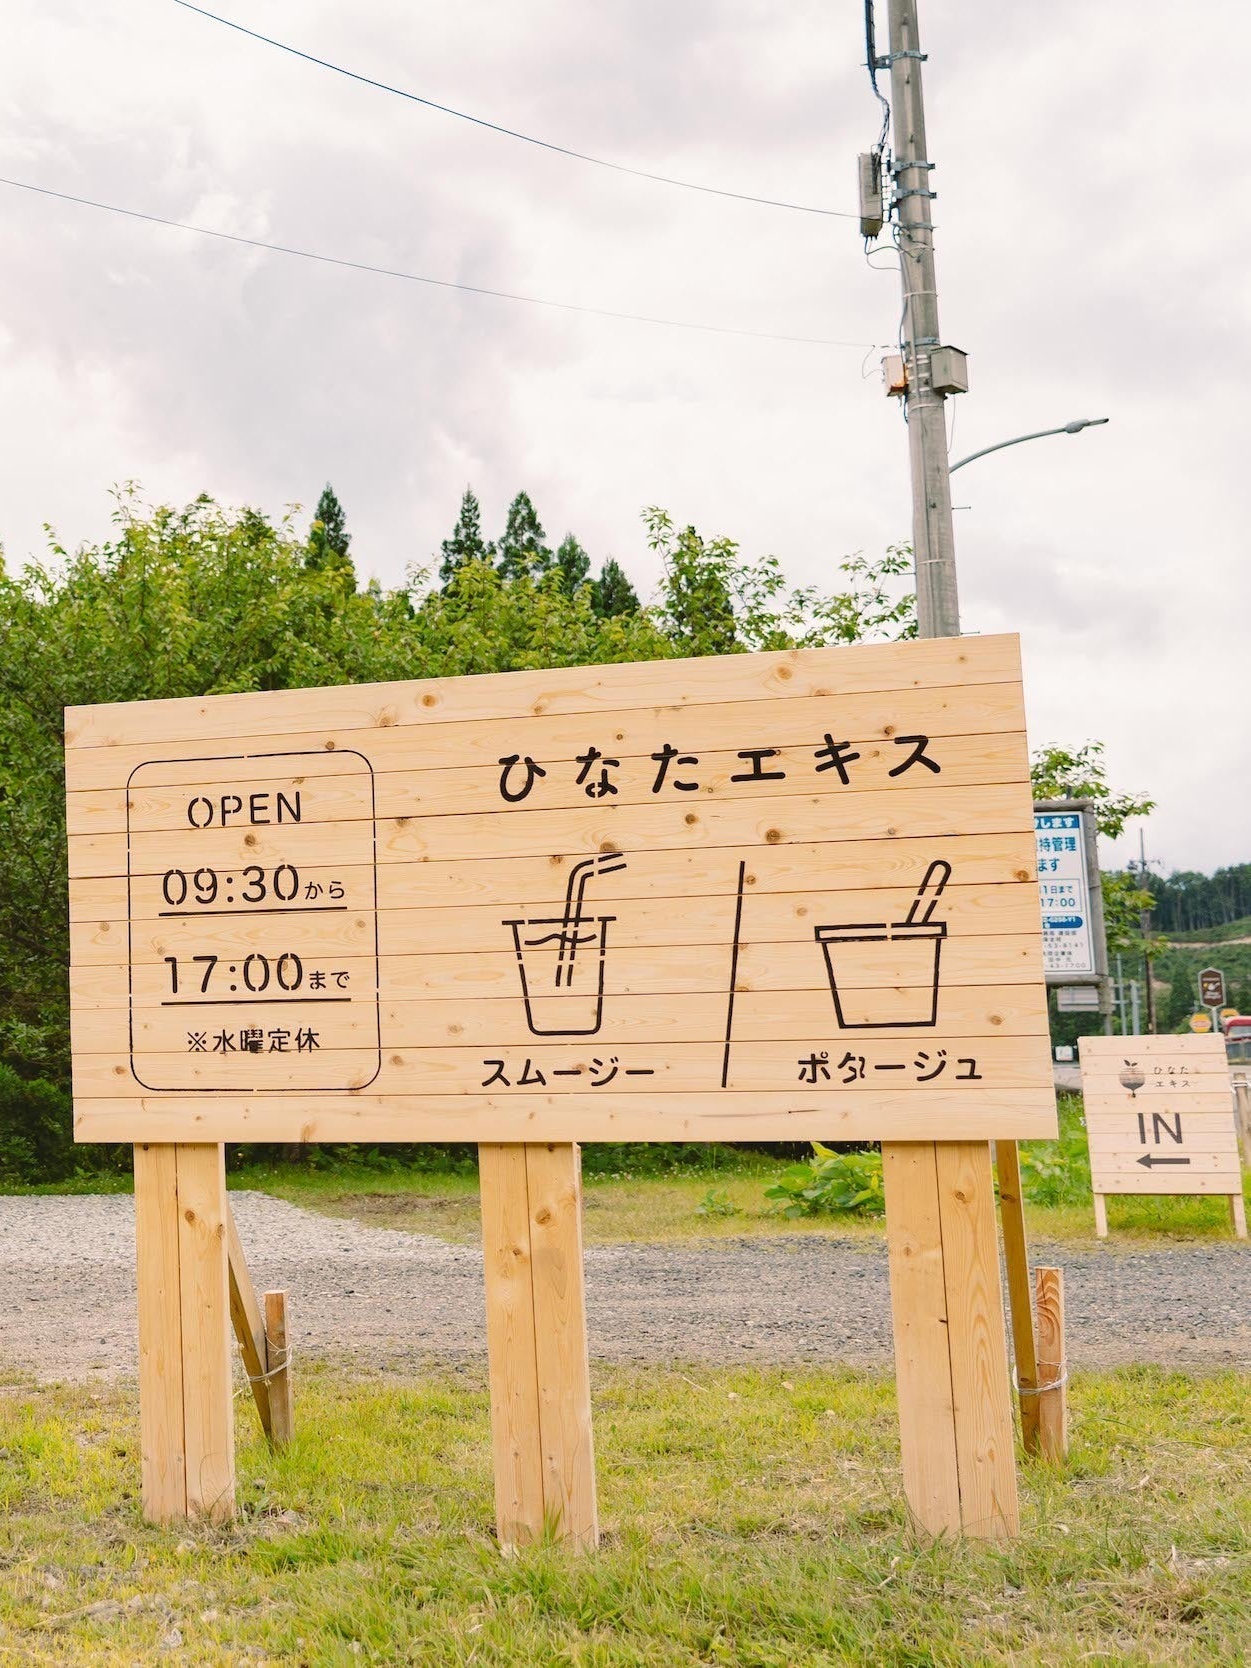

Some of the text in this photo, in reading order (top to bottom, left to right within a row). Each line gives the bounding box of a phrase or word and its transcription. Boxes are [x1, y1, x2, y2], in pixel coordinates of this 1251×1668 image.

[497, 733, 942, 803] ひなたエキス
[187, 791, 301, 829] OPEN
[1037, 836, 1077, 852] 持管理
[1039, 885, 1073, 895] 1日まで
[1040, 897, 1076, 907] 17:00
[481, 1056, 655, 1087] スムージー
[797, 1050, 983, 1084] ポタージュ
[1153, 1066, 1190, 1075] ひなた
[1154, 1079, 1191, 1088] エキス
[1137, 1112, 1183, 1145] IN
